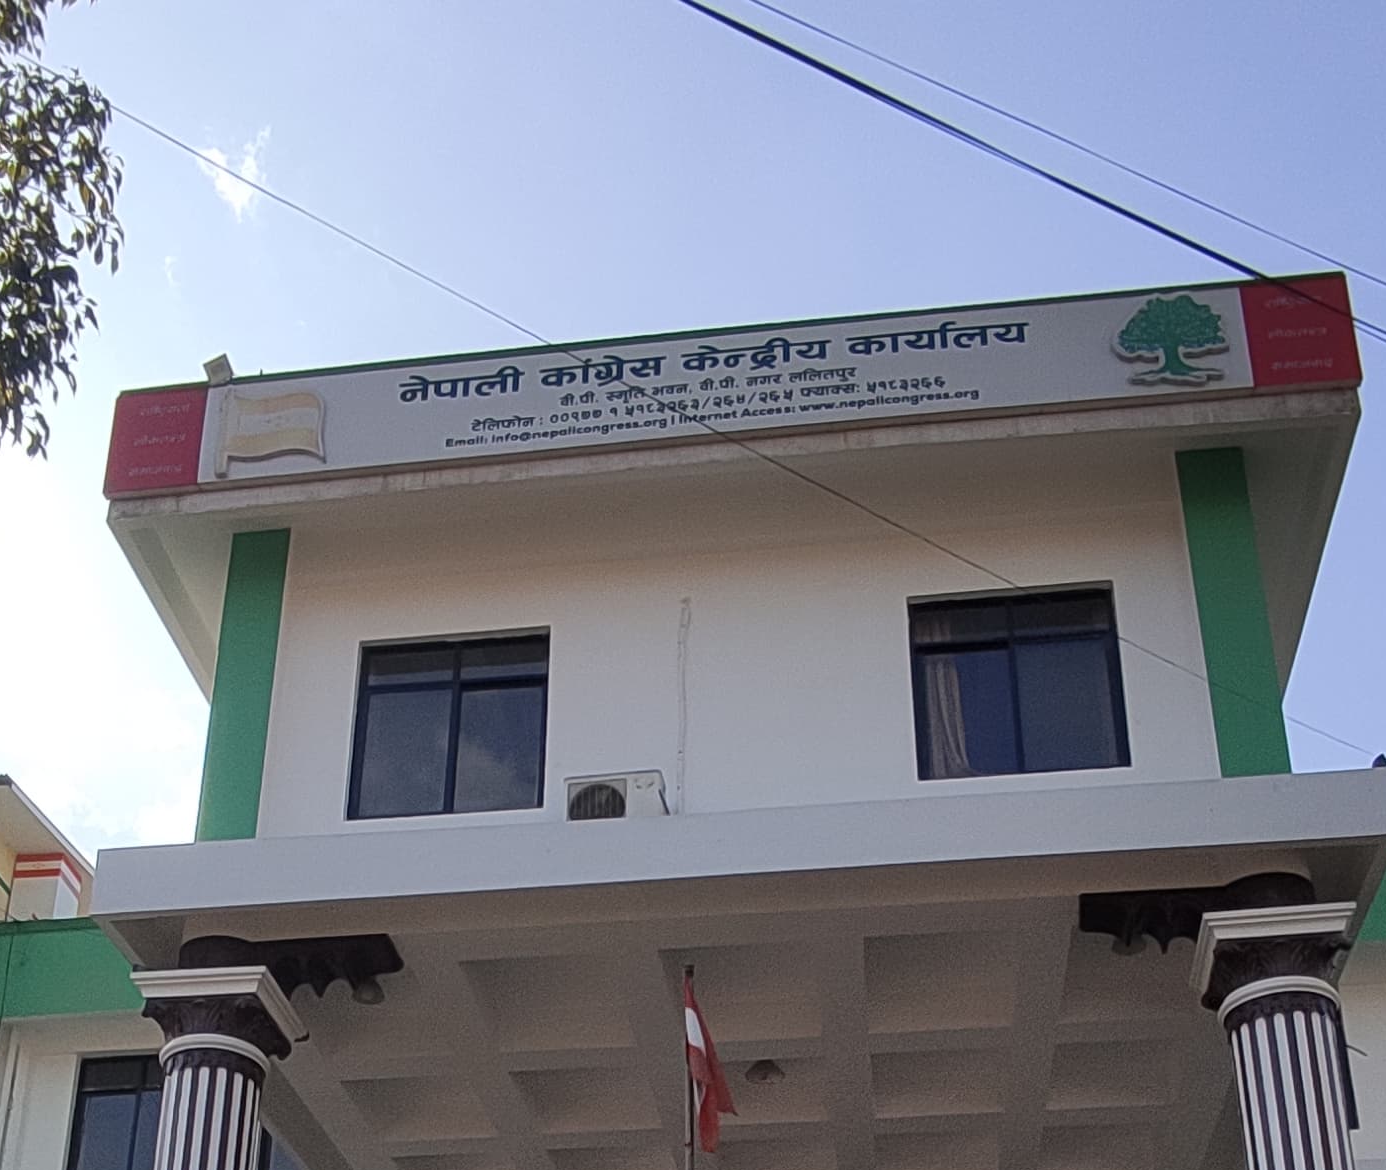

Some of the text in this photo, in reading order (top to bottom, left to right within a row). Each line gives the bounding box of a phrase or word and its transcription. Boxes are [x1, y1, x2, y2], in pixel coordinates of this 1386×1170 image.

[399, 366, 525, 402] नेपाली
[681, 337, 832, 371] केन्द्रीय
[845, 321, 1029, 355] कार्यालय
[746, 374, 782, 387] नगर
[789, 366, 857, 383] ललितपुर
[679, 409, 737, 424] Internet
[740, 406, 795, 418] Access:
[799, 389, 979, 412] www.nepalicongress.org
[471, 415, 535, 431] टेलिफोन
